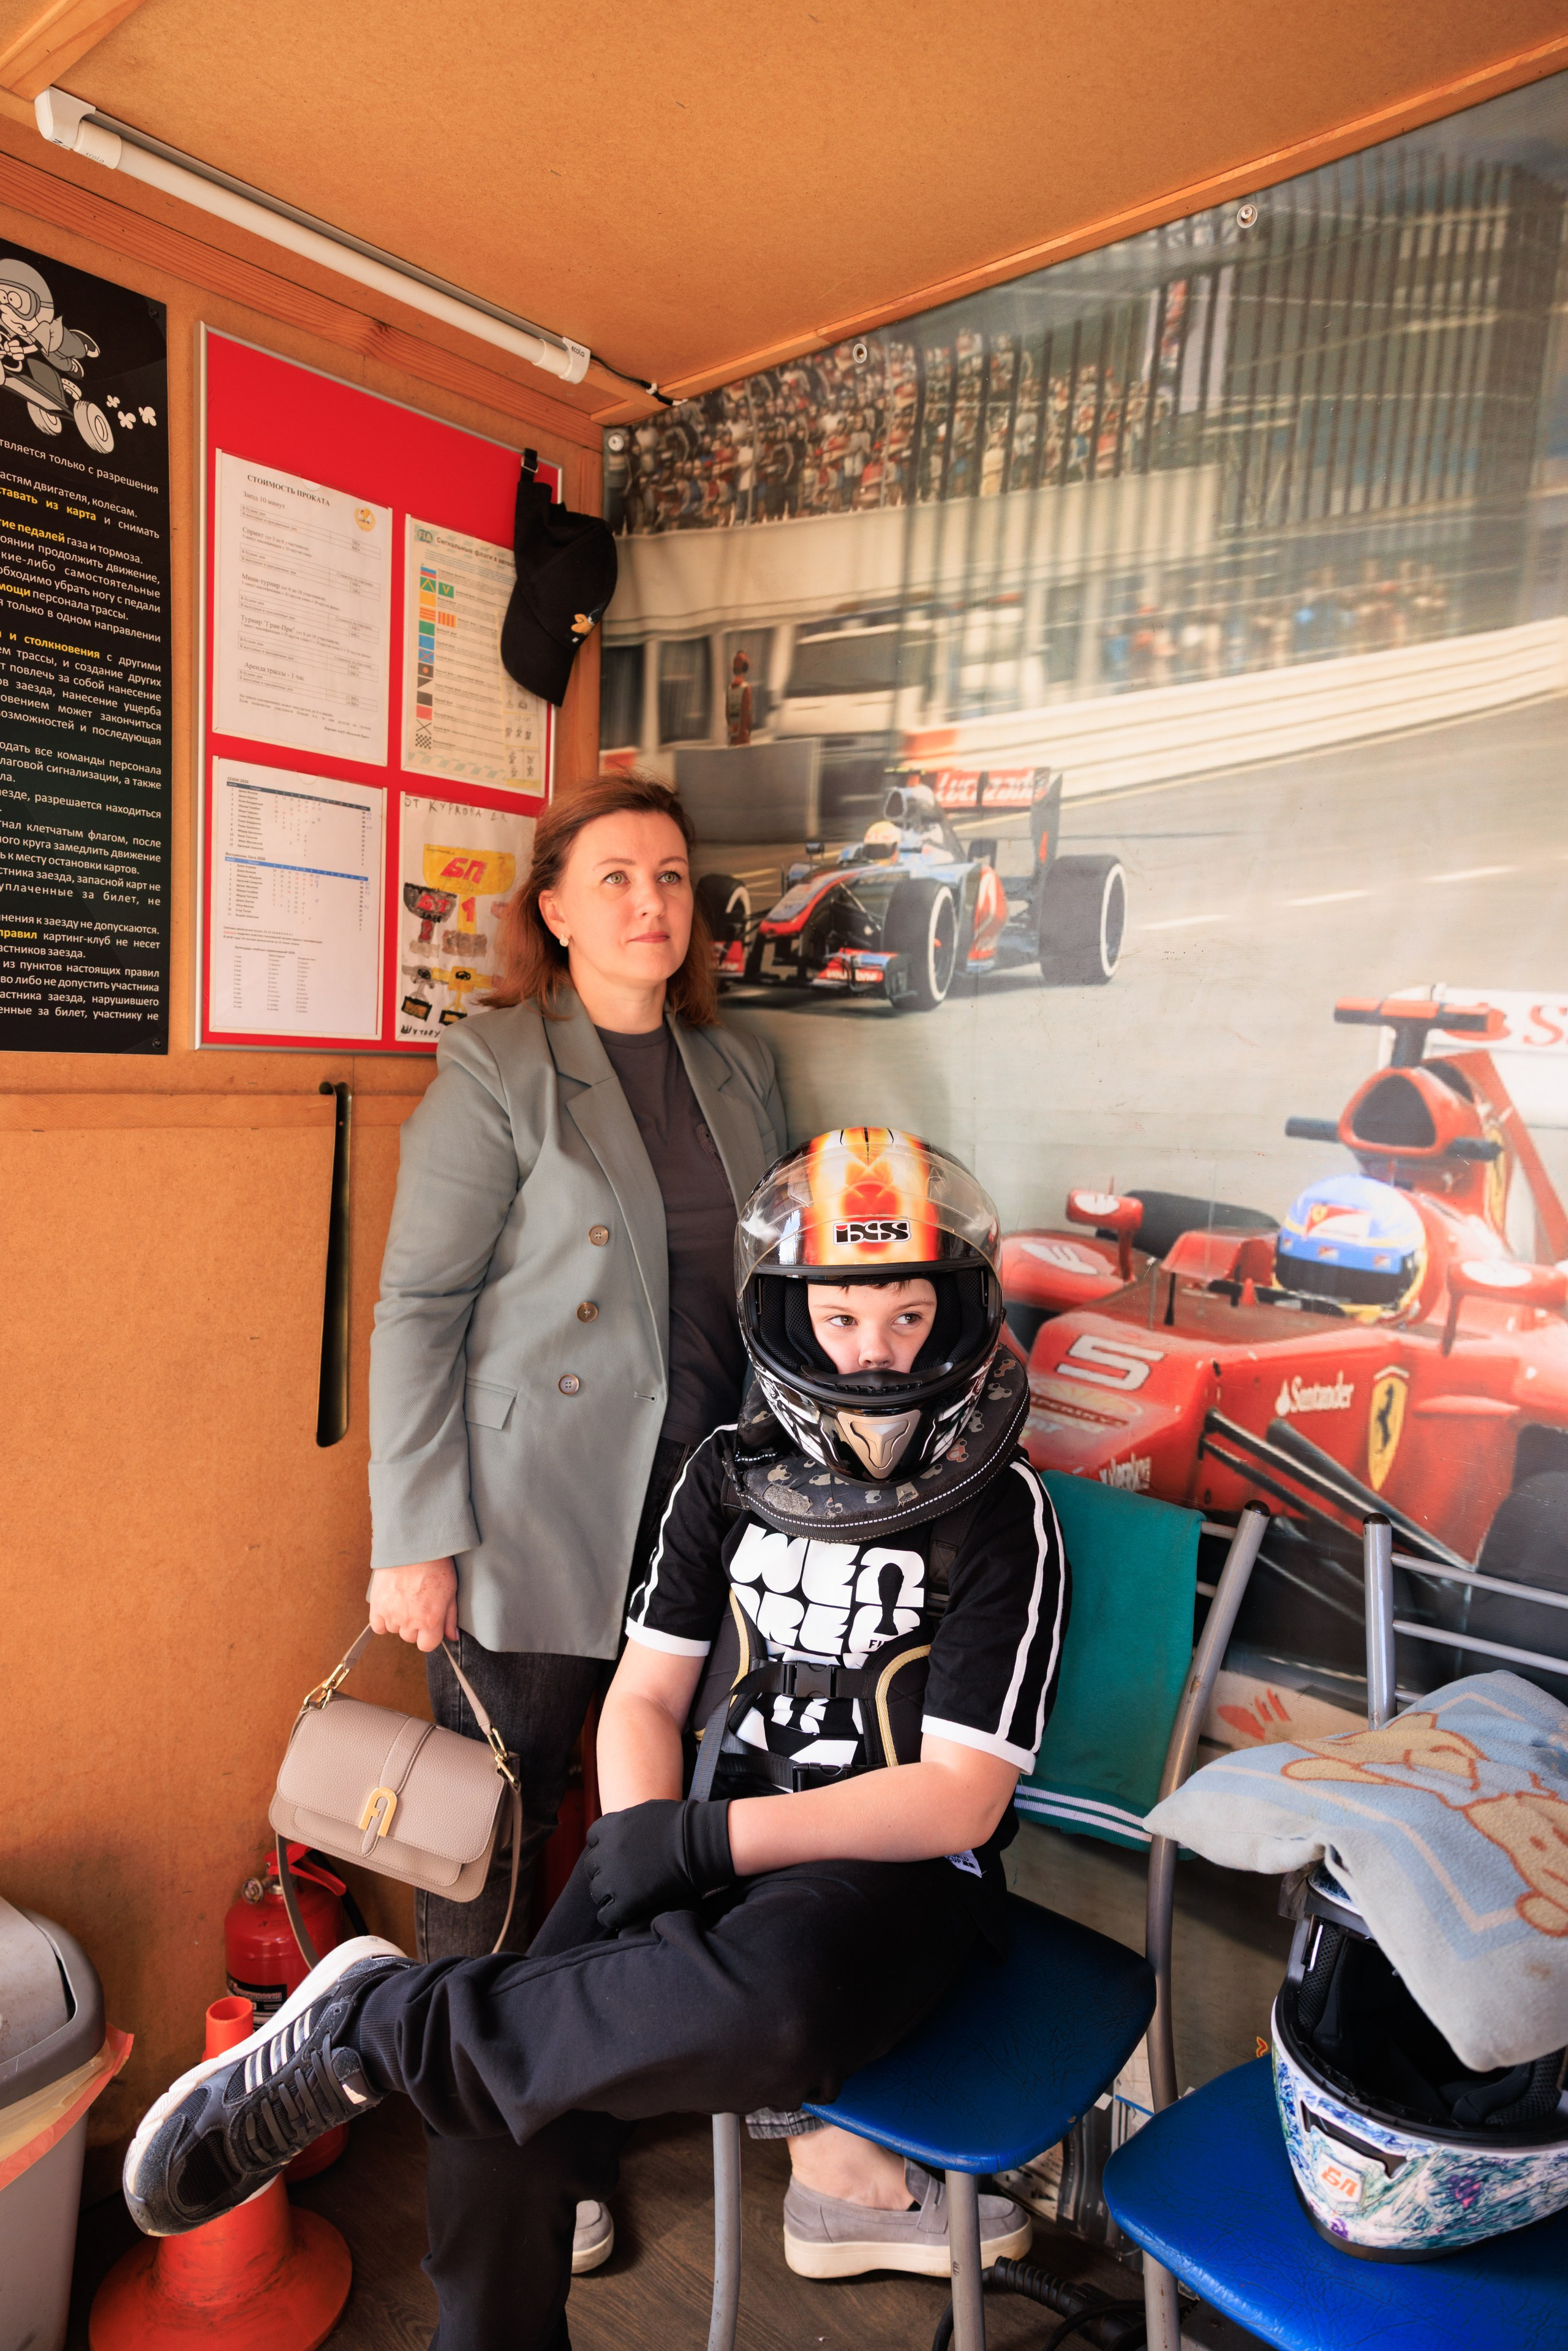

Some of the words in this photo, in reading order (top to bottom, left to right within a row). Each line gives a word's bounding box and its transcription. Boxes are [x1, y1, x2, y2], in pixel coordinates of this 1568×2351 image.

[49, 454, 85, 471] только
[97, 469, 158, 494] разрешения
[33, 481, 90, 505] двигателя,
[92, 498, 137, 518] колесам.
[243, 491, 258, 501] Заезд
[268, 500, 285, 509] минут
[247, 475, 295, 494] СТОИМОСТЬ
[297, 490, 330, 506] ПРОКАТА
[46, 500, 59, 510] из
[67, 506, 96, 521] карта
[118, 521, 159, 538] снимать
[18, 524, 65, 543] педалей
[67, 537, 88, 549] газа
[97, 545, 143, 564] тормоза.
[242, 527, 264, 538] Спринт
[418, 530, 432, 543] FIA
[437, 537, 473, 554] Сигнальные
[1, 551, 56, 572] кие-либо
[64, 568, 160, 598] самостоятельные
[38, 545, 104, 568] продолжить
[106, 564, 160, 584] движение,
[241, 573, 281, 589] Мини-турнир
[32, 591, 89, 611] персонала
[90, 605, 129, 620] трассы.
[54, 580, 90, 595] убрать
[92, 590, 115, 603] ногу
[124, 598, 160, 613] педали
[6, 600, 44, 616] только
[56, 612, 91, 627] одном
[94, 621, 160, 643] направлении
[240, 614, 262, 625] Турнир
[24, 636, 100, 659] столкновения
[118, 657, 161, 672] другими
[16, 650, 57, 666] трассы,
[75, 662, 123, 679] создание
[127, 674, 161, 687] других
[244, 662, 266, 672] Аренда
[267, 667, 286, 677] трассы
[10, 665, 55, 680] повлечь
[58, 674, 69, 683] за
[73, 677, 104, 690] собой
[108, 684, 161, 701] нанесение
[16, 681, 55, 697] заезда,
[62, 690, 118, 708] нанесение
[124, 703, 161, 716] ущерба
[58, 705, 92, 718] может
[100, 713, 161, 731] закончиться
[92, 726, 161, 745] последующая
[35, 747, 53, 757] все
[57, 751, 105, 766] команды
[109, 760, 161, 775] персонала
[47, 765, 121, 785] сигнализации,
[132, 779, 161, 790] также
[35, 794, 102, 810] разрешается
[106, 804, 161, 818] находиться
[27, 824, 83, 838] клетчатым
[88, 829, 128, 845] флагом,
[133, 837, 161, 848] после
[23, 839, 51, 850] круга
[53, 843, 109, 856] замедлить
[110, 850, 161, 862] движение
[15, 853, 47, 866] месту
[48, 858, 102, 870] остановки
[104, 864, 140, 874] картов.
[440, 857, 488, 885] БП
[36, 871, 75, 883] заезда,
[77, 875, 124, 887] запасной
[126, 881, 148, 891] карт
[103, 891, 139, 905] билет,
[43, 918, 79, 929] заезду
[94, 923, 159, 934] допускаются.
[43, 933, 111, 946] картинг-клуб
[134, 940, 160, 949] несет
[48, 948, 86, 959] заезда.
[20, 962, 62, 972] пунктов
[67, 965, 121, 976] настоящих
[125, 968, 159, 978] правил
[15, 975, 42, 985] либо
[58, 979, 110, 989] допустить
[111, 983, 159, 992] участника
[48, 994, 86, 1004] заезда,
[92, 996, 159, 1006] нарушившего
[55, 1006, 88, 1019] билет,
[92, 1011, 142, 1022] участнику
[1056, 1335, 1167, 1391] 5
[1291, 1370, 1355, 1413] Santander
[869, 1639, 885, 1649] FI
